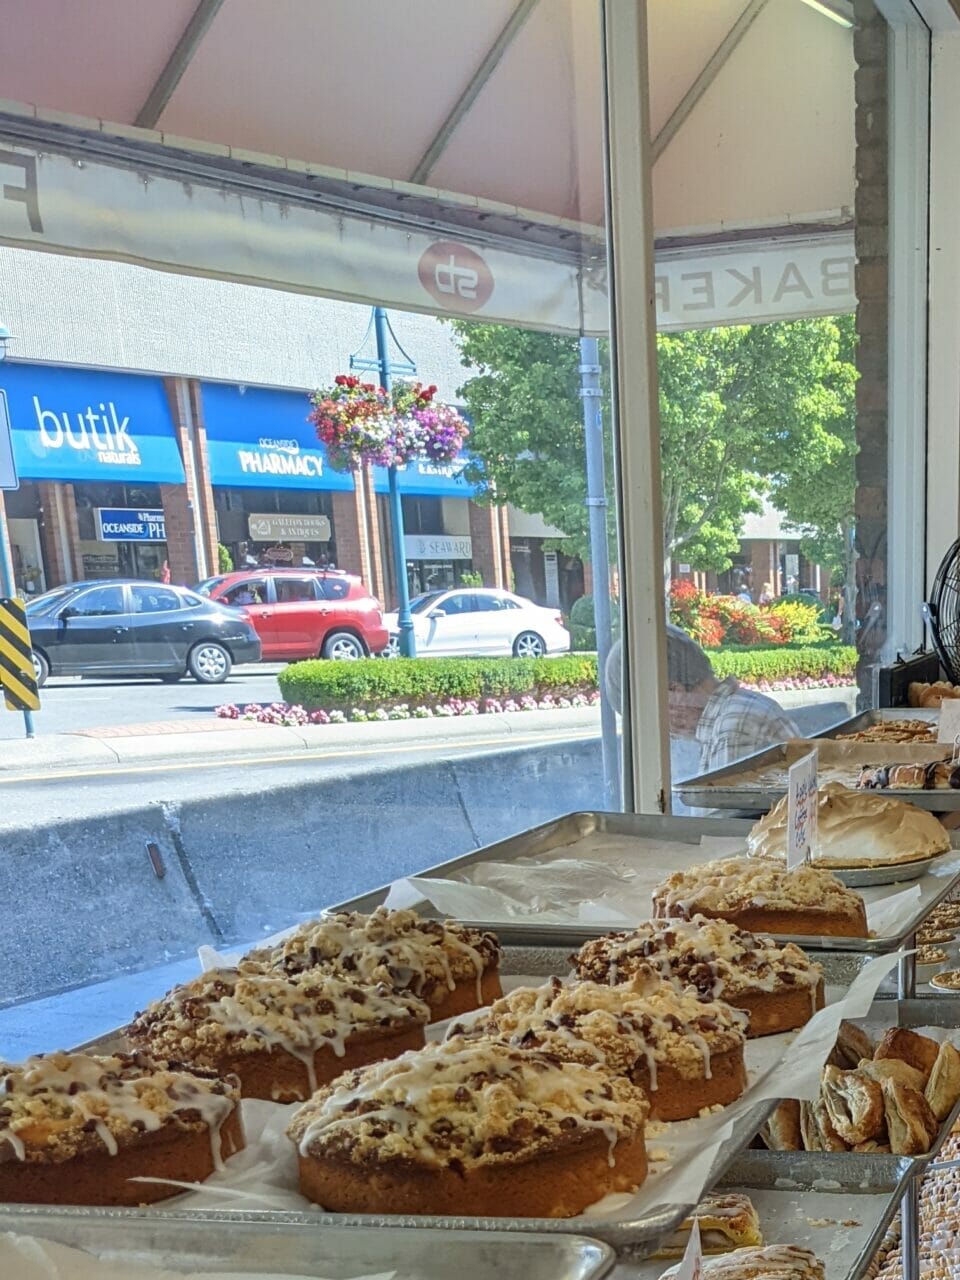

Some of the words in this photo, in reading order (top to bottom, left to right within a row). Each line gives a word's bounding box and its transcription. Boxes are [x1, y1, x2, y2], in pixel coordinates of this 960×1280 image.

[33, 395, 138, 451] butik
[258, 437, 299, 450] OCEANSIDE
[97, 451, 142, 466] naturals
[238, 450, 323, 477] PHARMACY
[102, 522, 145, 534] OCEANSIDE
